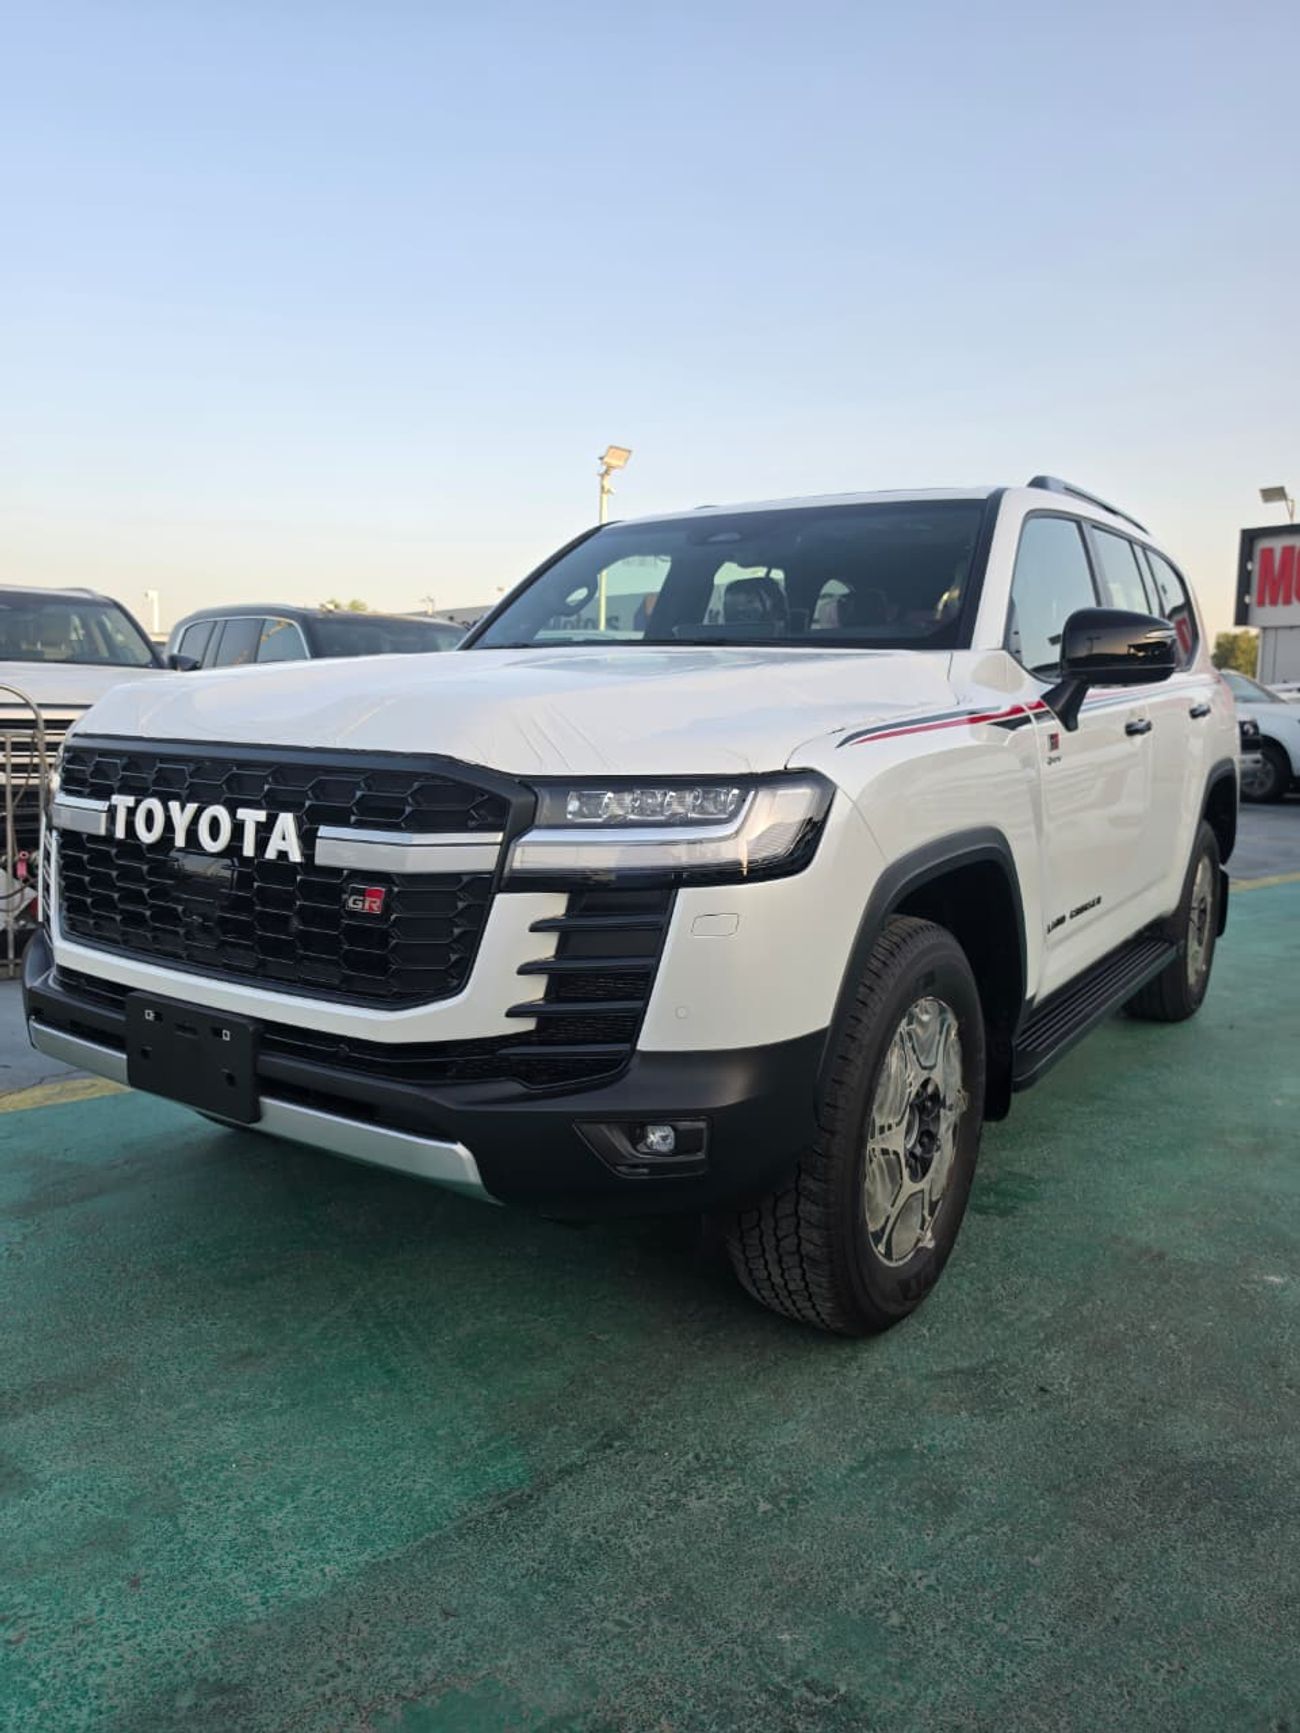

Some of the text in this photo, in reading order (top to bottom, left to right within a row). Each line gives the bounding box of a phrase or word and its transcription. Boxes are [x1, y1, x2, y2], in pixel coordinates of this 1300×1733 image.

[1256, 544, 1300, 608] M
[111, 795, 304, 862] TOYOTA
[348, 895, 382, 912] GR
